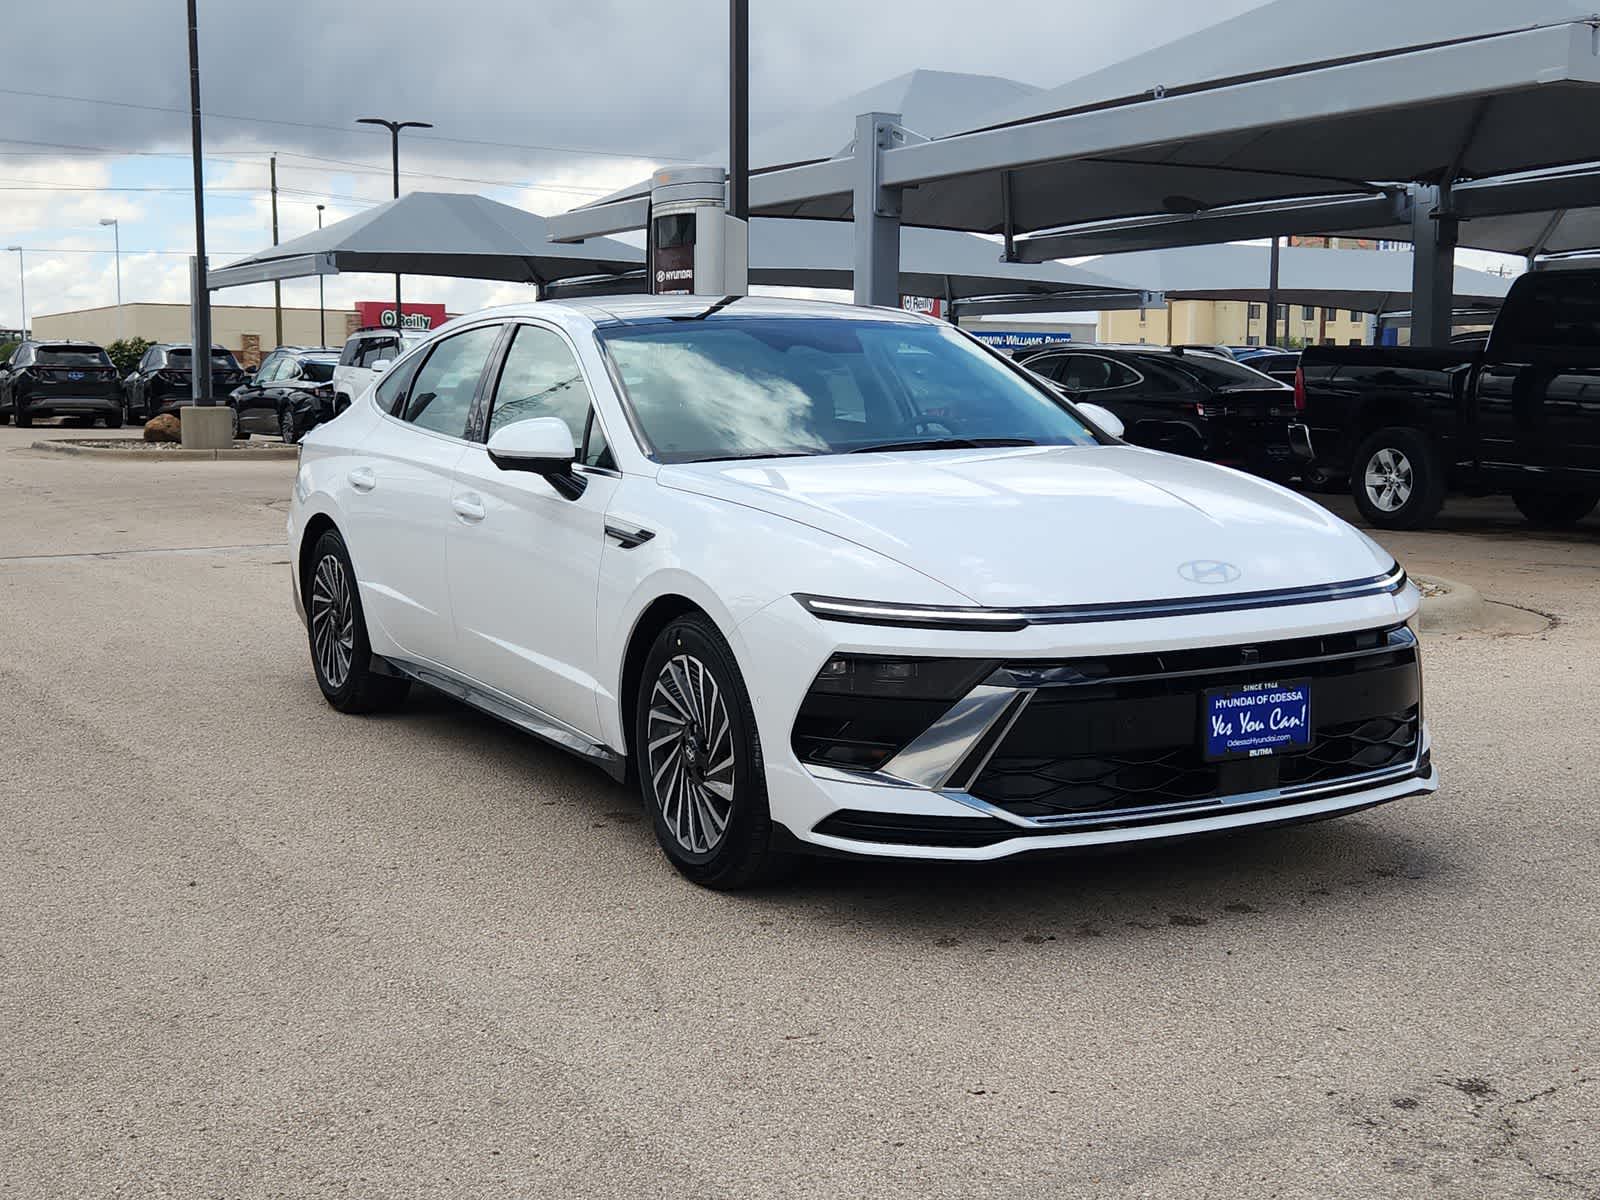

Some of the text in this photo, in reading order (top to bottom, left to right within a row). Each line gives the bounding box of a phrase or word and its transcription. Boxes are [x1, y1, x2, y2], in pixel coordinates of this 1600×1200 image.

[666, 269, 693, 280] HYUNDAI
[381, 310, 432, 329] OReilly
[978, 335, 1043, 346] ERWIN-WILLIAMS
[1242, 683, 1263, 692] SINCE
[1215, 691, 1303, 709] HYUNDAI OF ODESSA
[1211, 704, 1306, 737] Yes You Can!
[1227, 734, 1292, 747] OdessaHyundai.com
